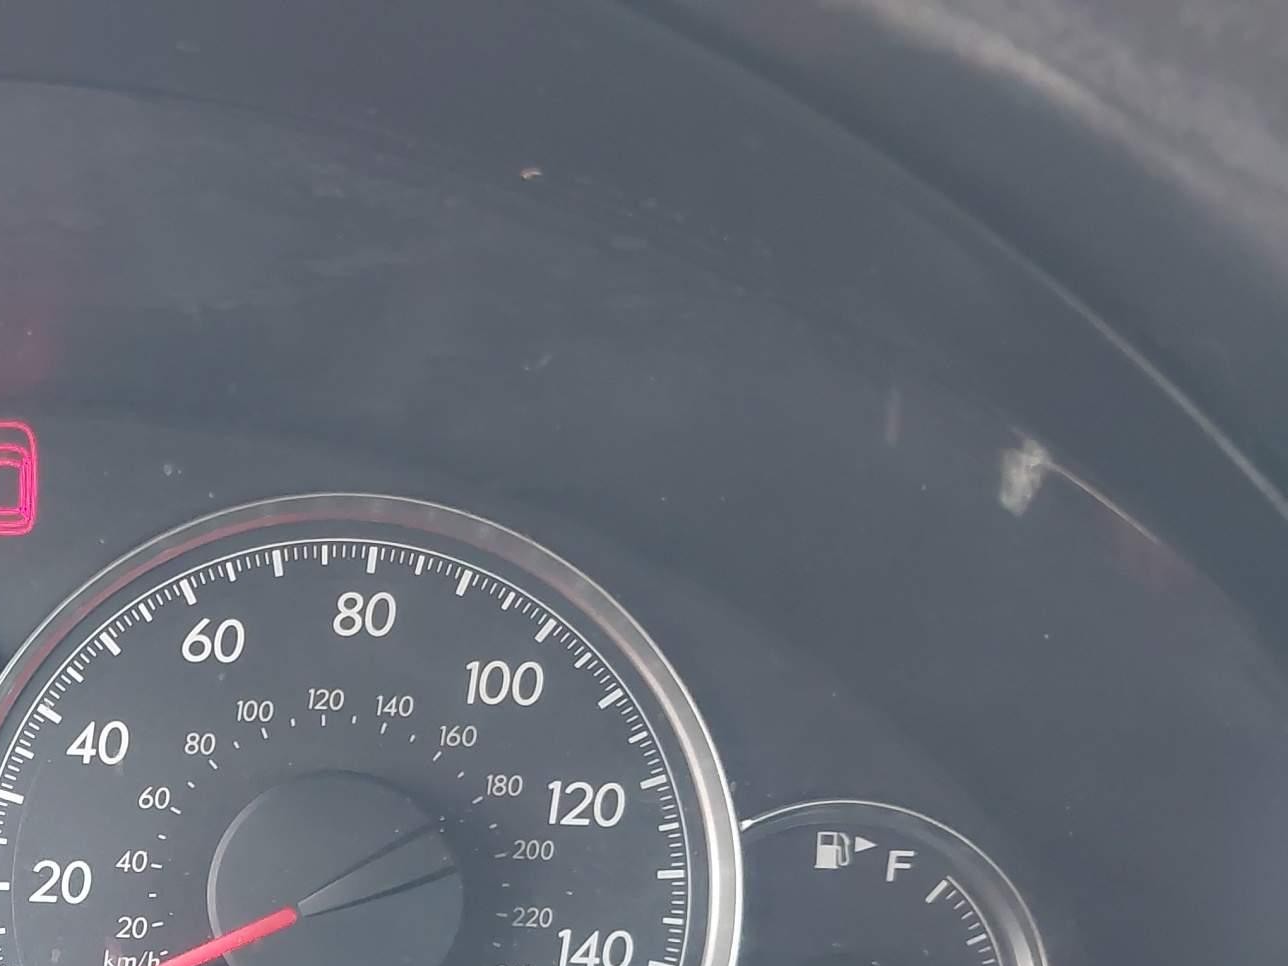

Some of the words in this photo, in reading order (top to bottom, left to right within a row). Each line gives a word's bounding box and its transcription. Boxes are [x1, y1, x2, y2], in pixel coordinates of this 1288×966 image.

[333, 591, 397, 637] 80
[181, 617, 245, 663] 60
[466, 660, 544, 706] 100
[236, 700, 274, 722] 100
[308, 688, 345, 711] 120
[376, 695, 414, 717] 140
[66, 720, 129, 765] 40
[184, 732, 216, 756] 80
[439, 725, 478, 747] 160
[487, 774, 524, 797] 180
[138, 786, 170, 810] 60
[548, 780, 626, 827] 120
[115, 850, 148, 873] 40
[512, 839, 555, 861] 200
[886, 850, 915, 882] F
[28, 859, 92, 905] 20
[115, 916, 148, 939] 20
[512, 907, 553, 928] 220
